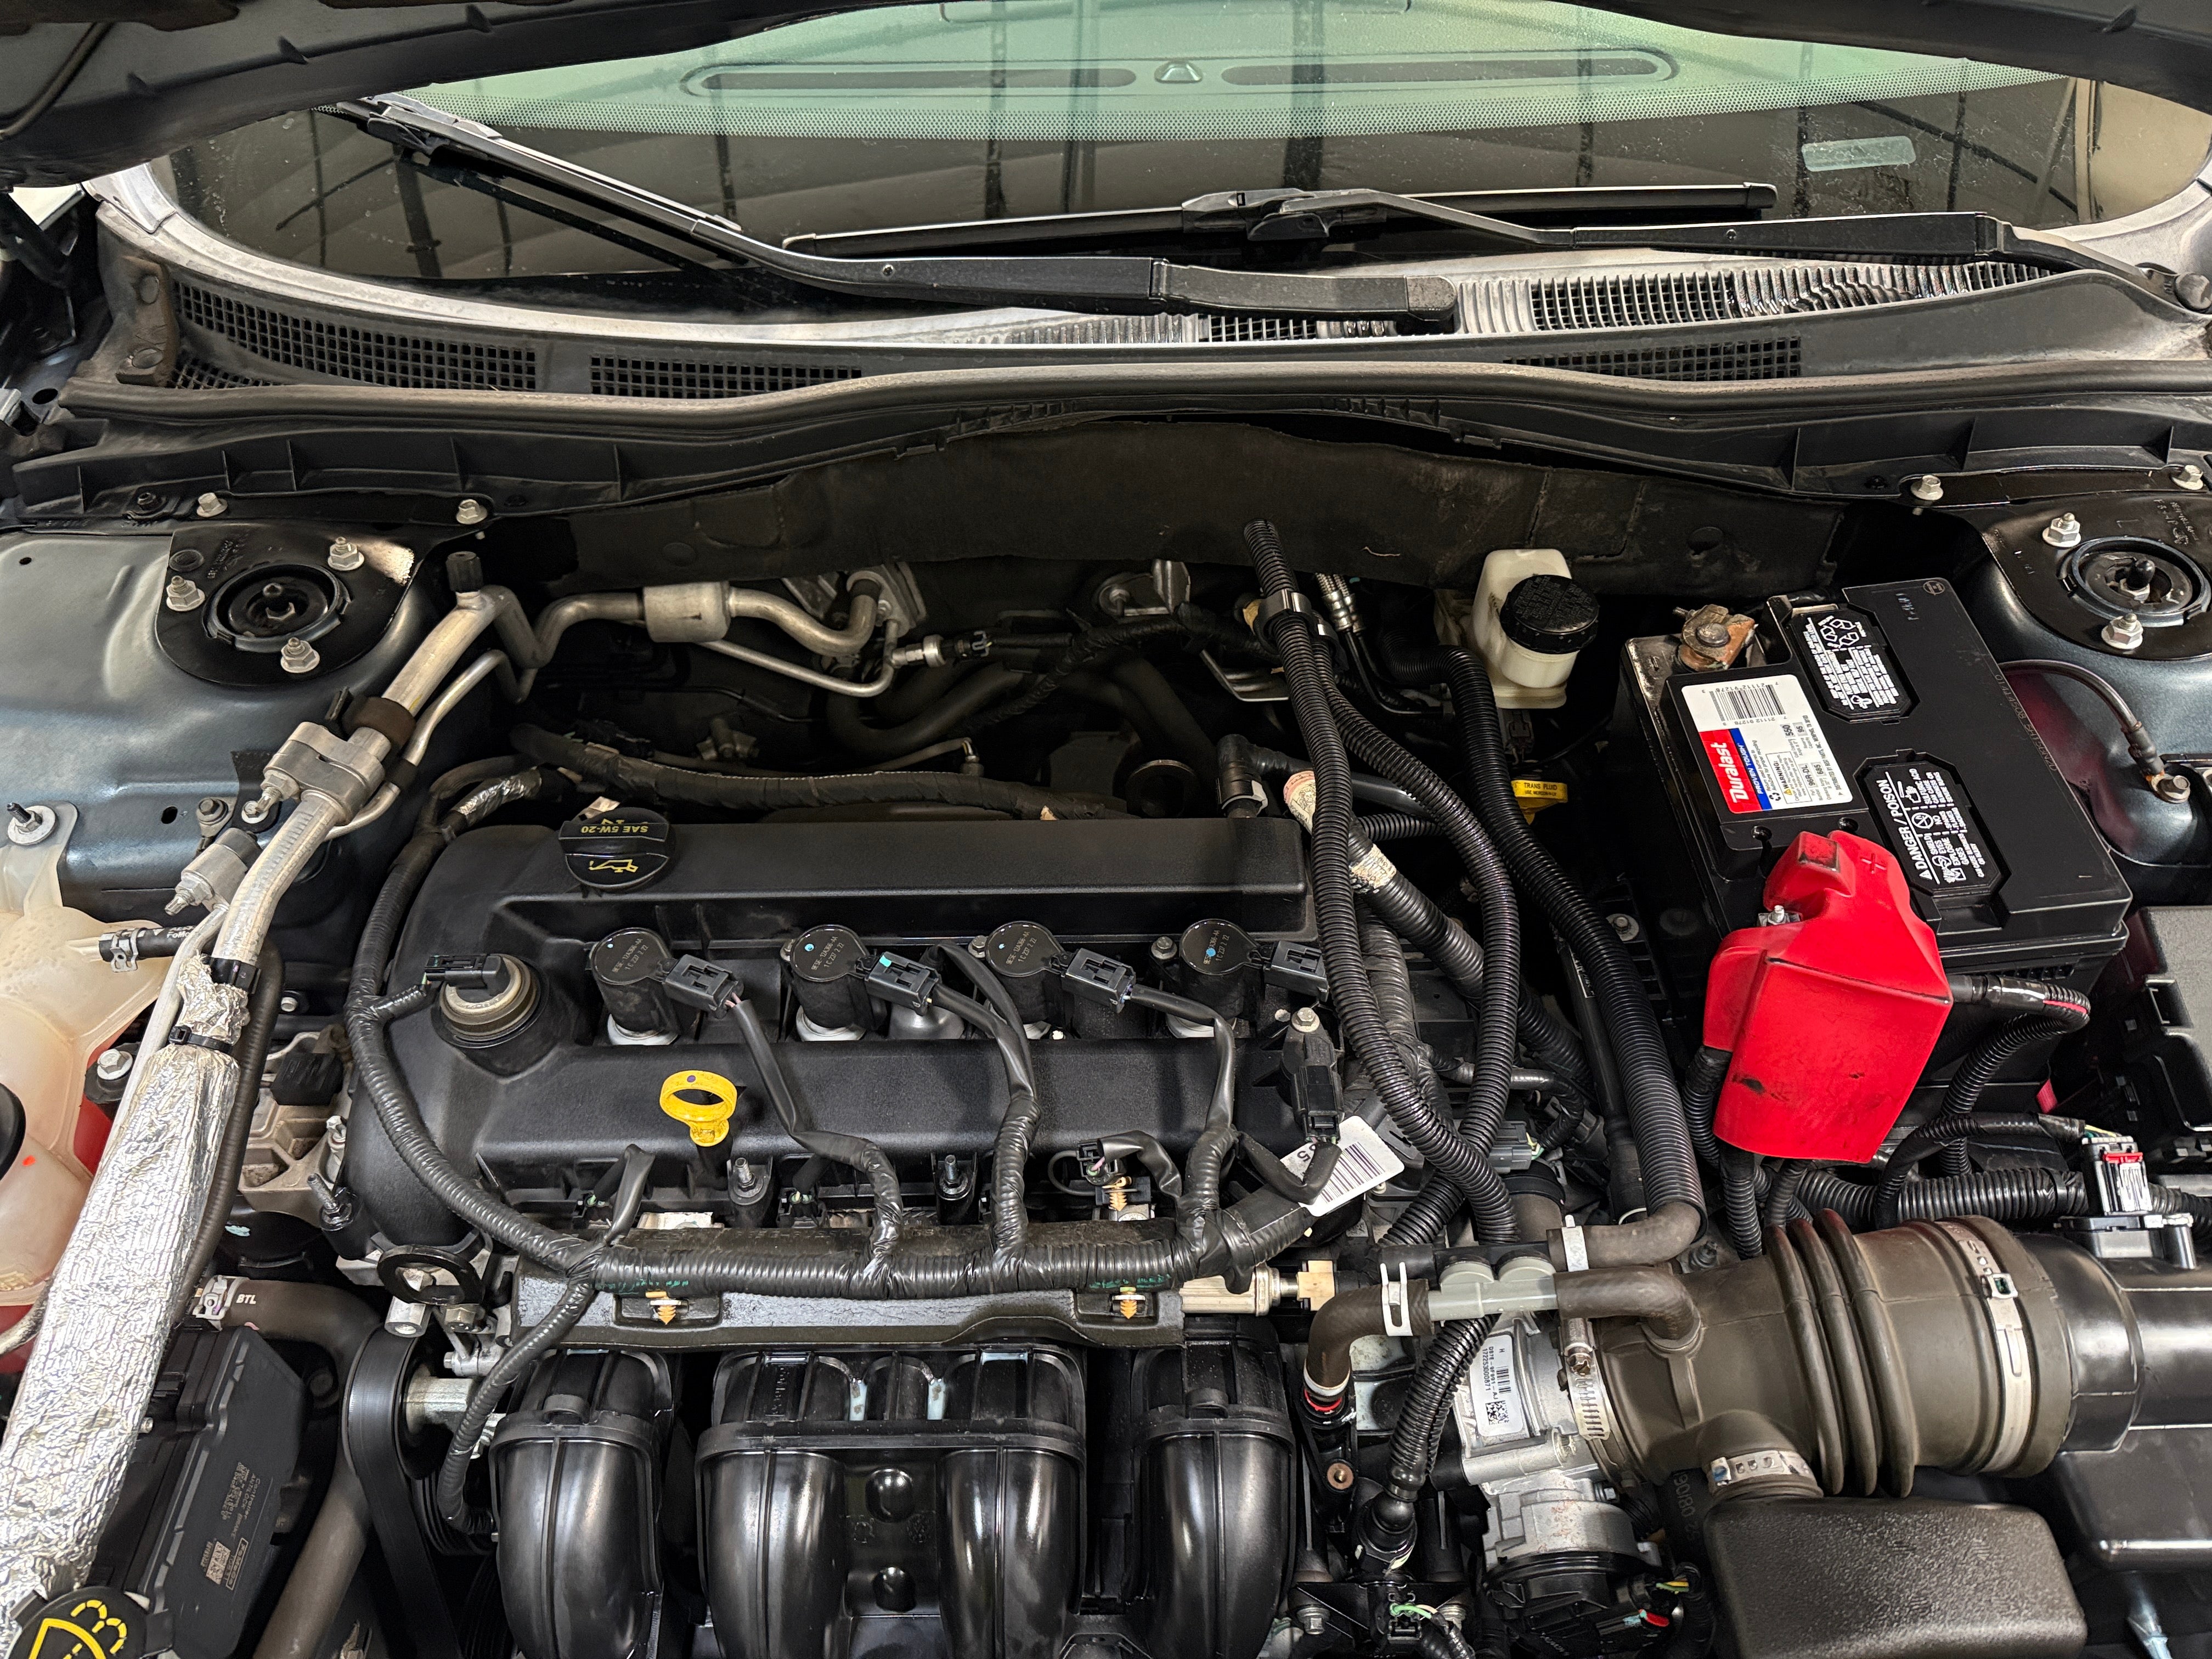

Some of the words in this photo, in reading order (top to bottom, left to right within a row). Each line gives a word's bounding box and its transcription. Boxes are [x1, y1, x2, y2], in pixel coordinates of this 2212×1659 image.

[1781, 724, 1794, 736] 550
[1709, 740, 1750, 803] Duralast
[1771, 760, 1789, 789] WARNING:
[1800, 764, 1815, 786] 96R-DL
[1813, 764, 1824, 774] 685
[1908, 768, 1921, 781] ACID
[1747, 766, 1764, 794] PROVEN
[1922, 779, 1935, 794] CAUSE
[1914, 780, 1933, 805] SULFURIC
[1929, 793, 1940, 804] CAN
[1939, 786, 1954, 803] SEVERE
[1931, 814, 1943, 825] NO
[580, 825, 619, 833] 5W-20
[1922, 835, 1939, 855] SHIELD
[1933, 839, 1947, 854] EYES
[1940, 837, 1962, 866] EXPLOSIVE
[1954, 847, 1971, 865] GASES
[1974, 868, 1985, 878] CAN
[236, 1294, 257, 1305] BTL
[1481, 1347, 1491, 1391] 172253000871
[240, 1472, 256, 1509] ANTILOCK
[242, 1477, 262, 1520] Controller
